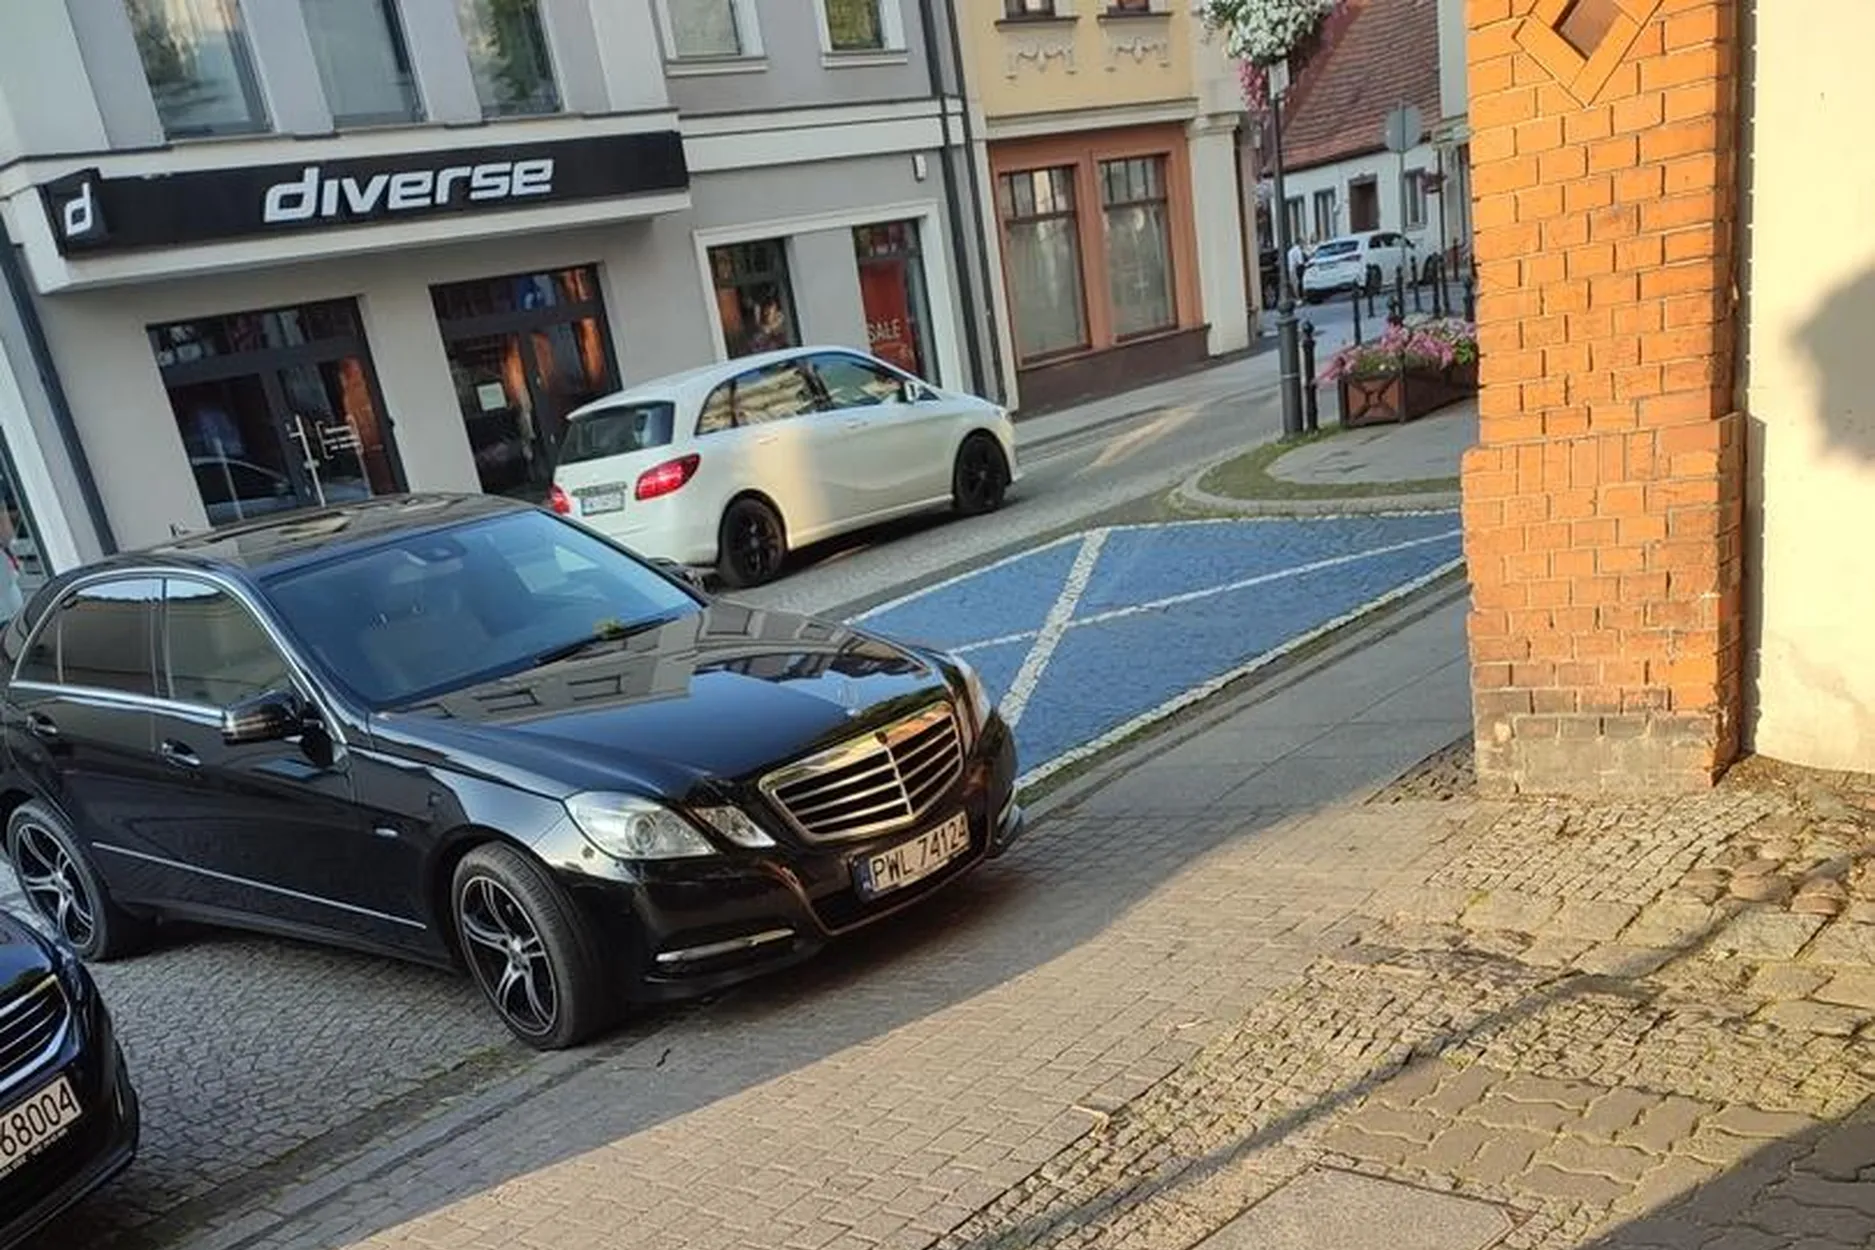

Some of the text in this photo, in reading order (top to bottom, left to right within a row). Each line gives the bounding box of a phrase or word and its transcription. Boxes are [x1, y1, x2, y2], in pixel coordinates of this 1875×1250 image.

[64, 182, 93, 236] d
[263, 158, 555, 223] diverse
[867, 317, 902, 343] SALE
[872, 852, 912, 889] PWL
[0, 1081, 78, 1157] 68004
